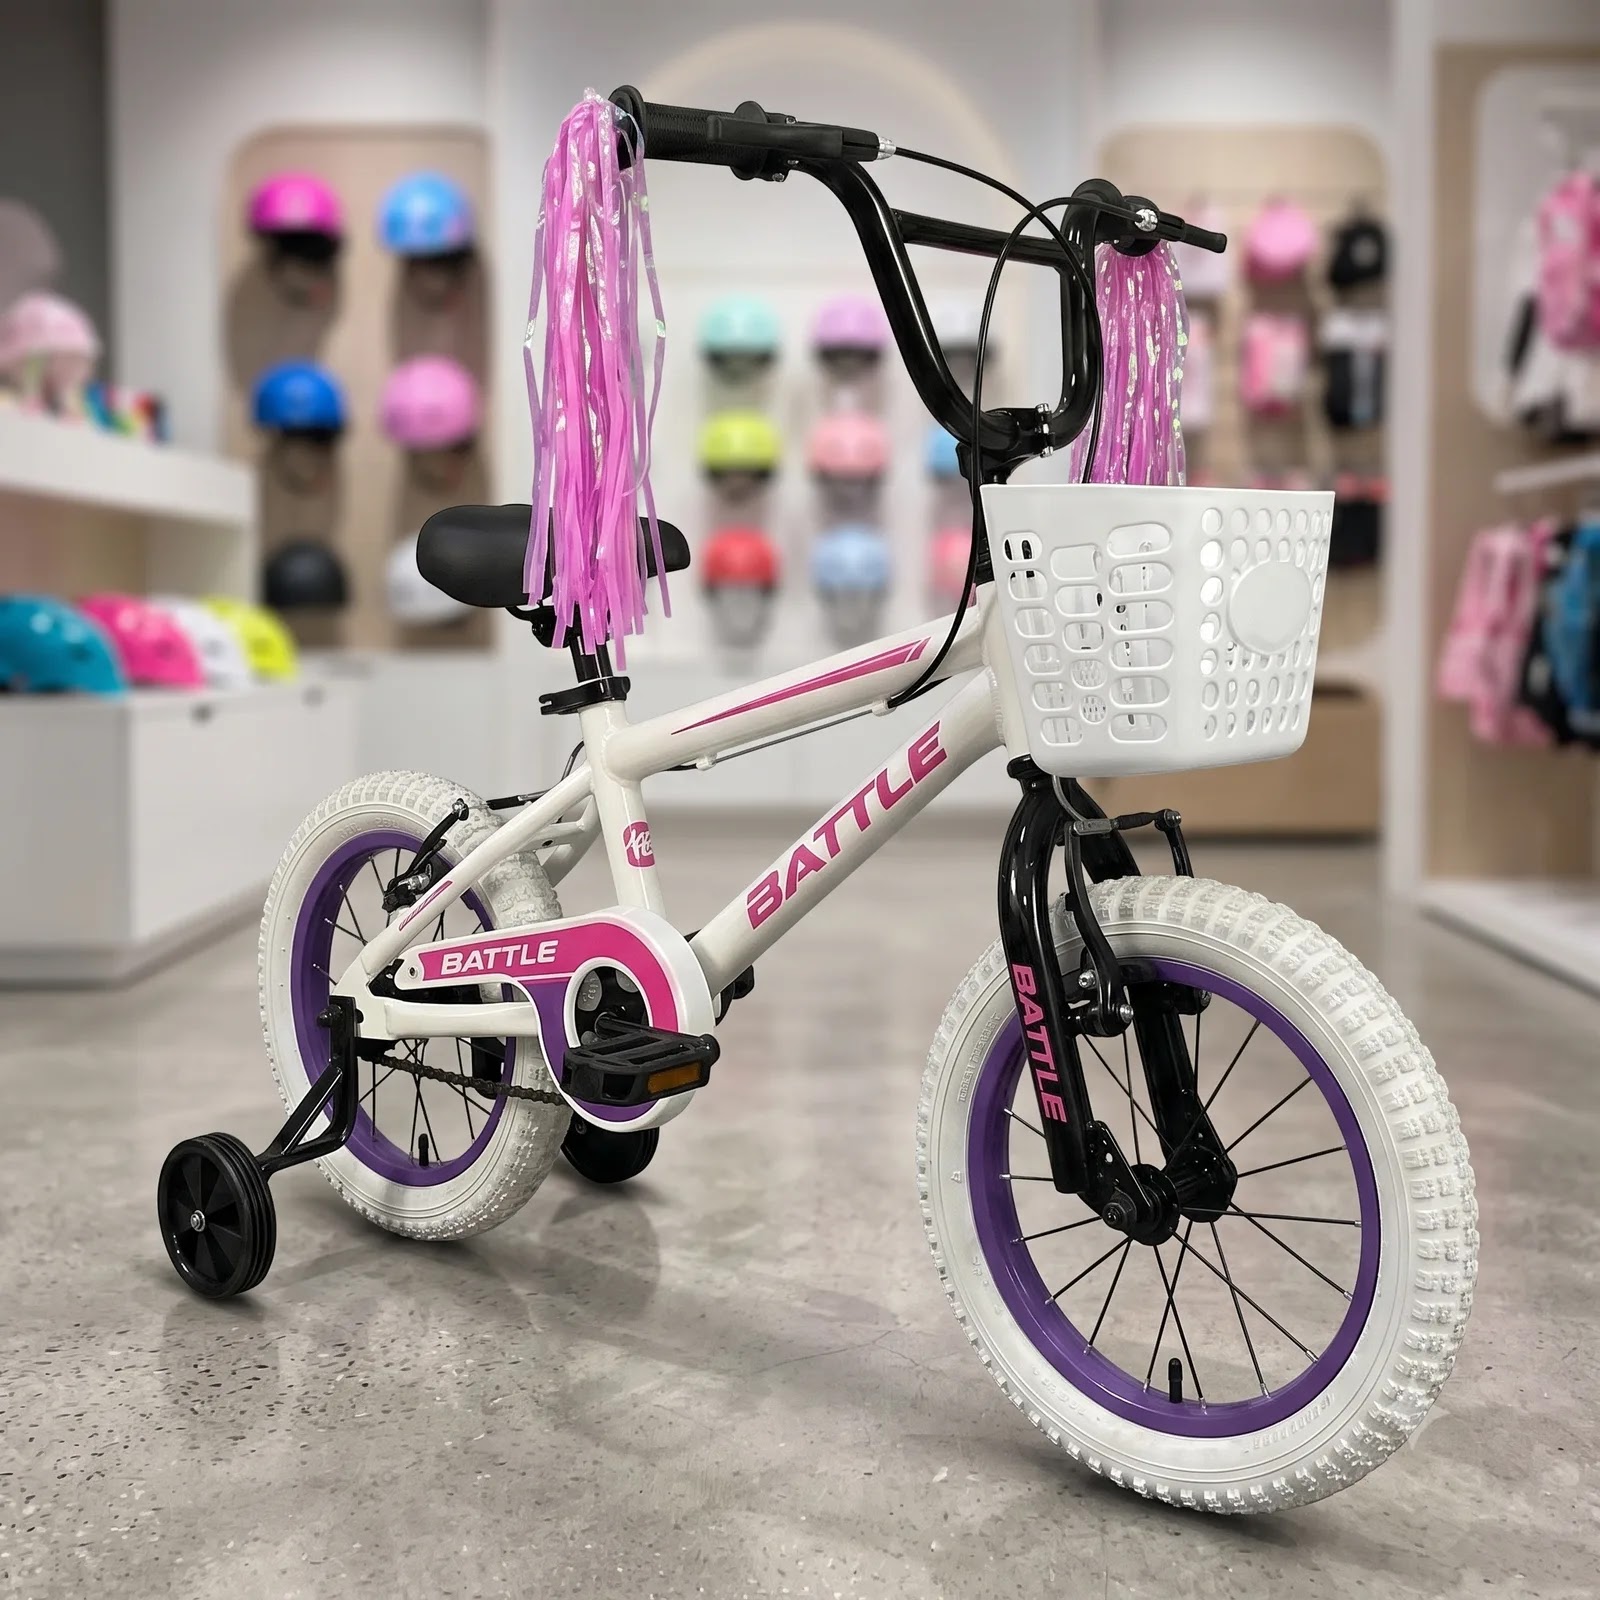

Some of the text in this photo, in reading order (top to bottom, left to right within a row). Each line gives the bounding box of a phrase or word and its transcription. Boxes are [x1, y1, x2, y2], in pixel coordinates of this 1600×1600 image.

[747, 720, 948, 930] BATTLE
[440, 939, 559, 976] BATTLE
[1011, 963, 1068, 1123] BATTLE
